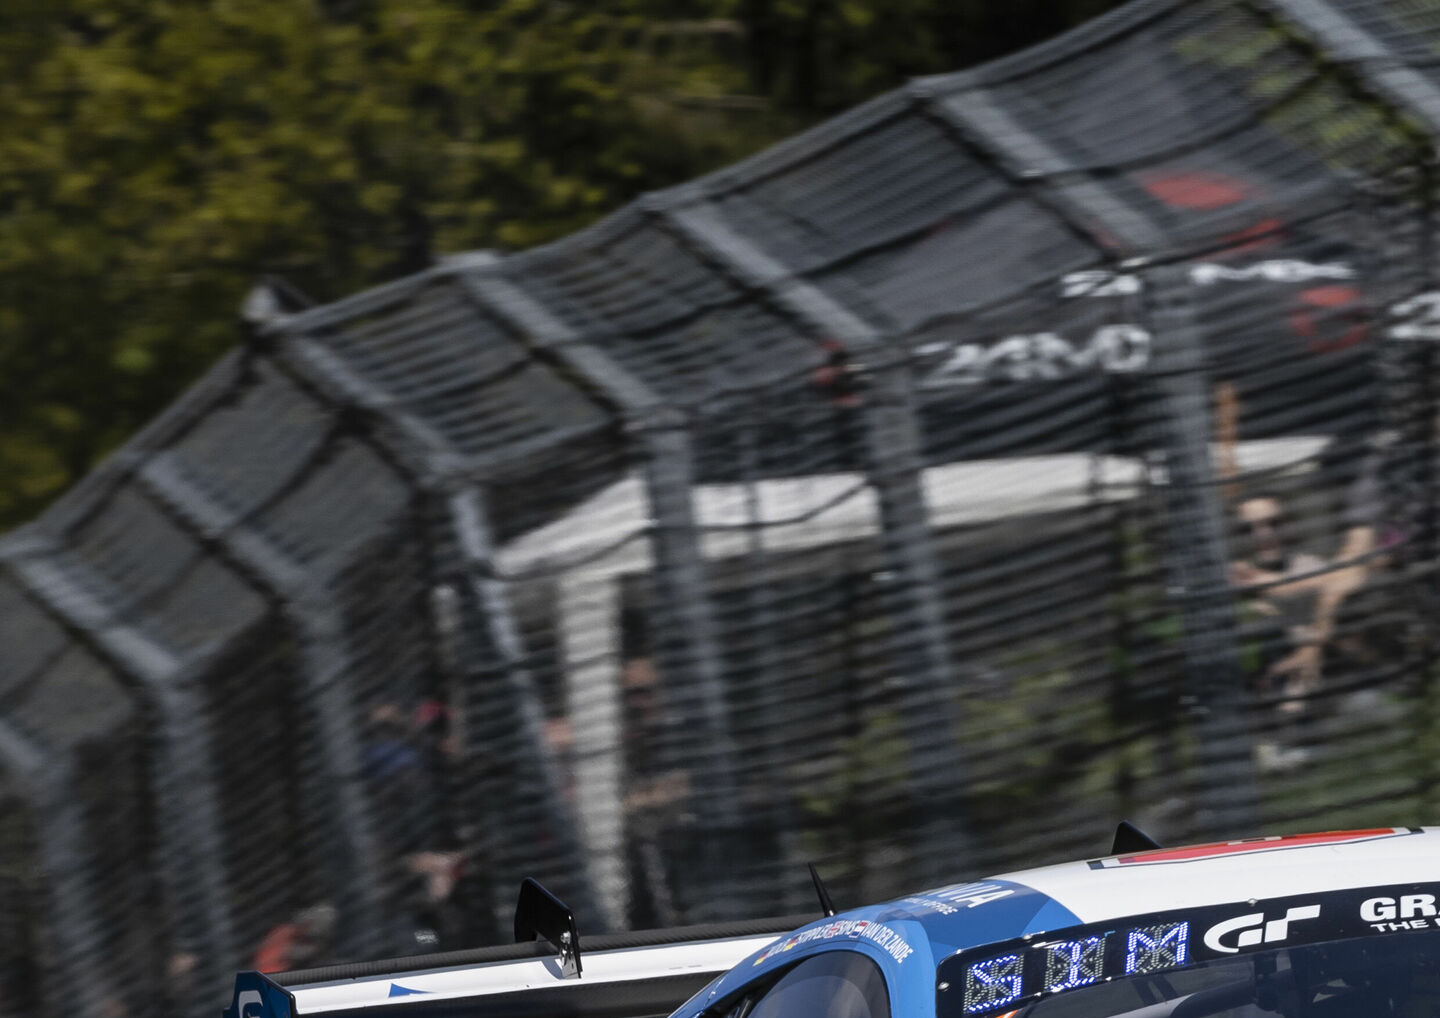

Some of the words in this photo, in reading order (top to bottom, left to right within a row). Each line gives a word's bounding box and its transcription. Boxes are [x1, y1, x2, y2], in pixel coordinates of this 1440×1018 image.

[1371, 919, 1427, 933] THE
[873, 926, 894, 947] DER
[884, 934, 914, 964] ZANDE
